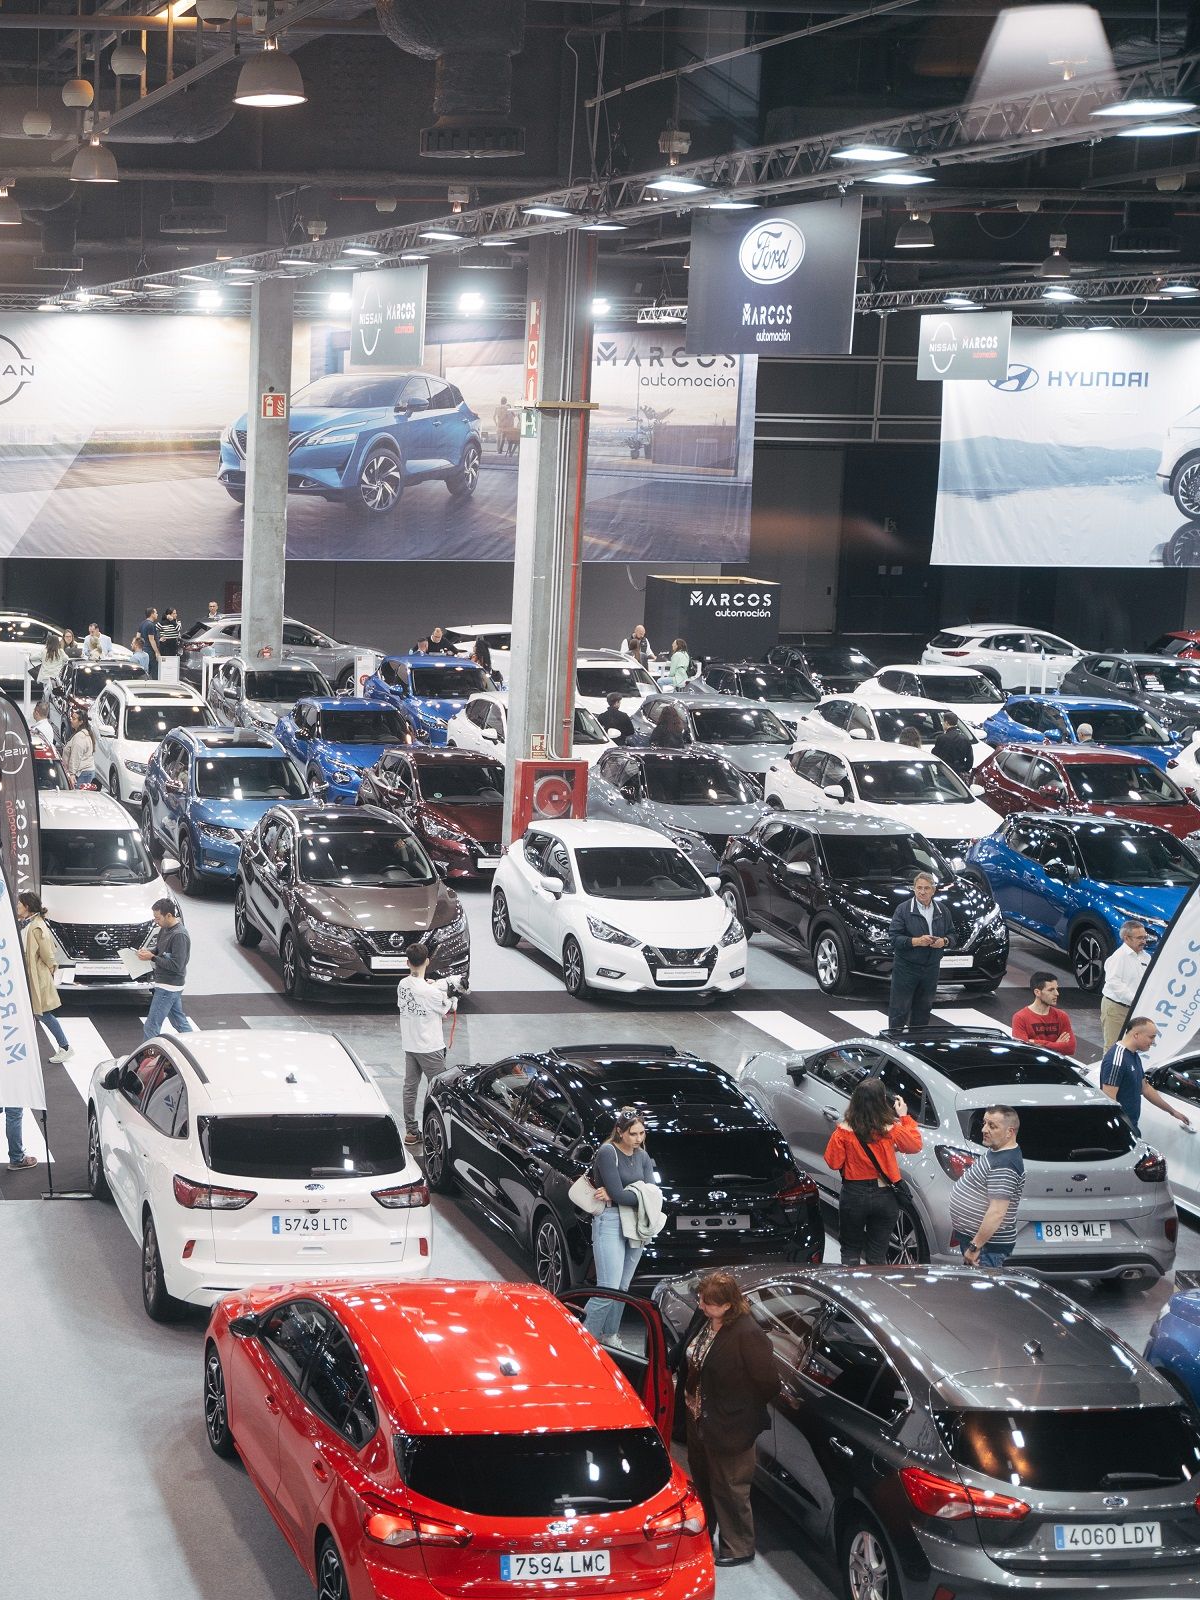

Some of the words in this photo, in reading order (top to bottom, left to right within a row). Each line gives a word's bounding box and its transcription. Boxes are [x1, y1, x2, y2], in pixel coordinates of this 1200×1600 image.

[751, 230, 792, 271] Ford
[359, 312, 383, 325] NISSAN
[742, 303, 793, 326] MARCOS
[756, 329, 791, 342] automoción
[962, 335, 999, 349] MARCOS
[928, 343, 958, 352] NISSAN
[640, 372, 736, 388] automoción
[1047, 370, 1149, 388] HYUNDAI
[689, 590, 772, 607] MARCOS
[714, 608, 771, 618] automoción
[284, 1218, 319, 1231] 5749
[323, 1218, 348, 1231] LTC
[1045, 1224, 1079, 1237] 8819
[1083, 1223, 1106, 1237] MLF
[1069, 1527, 1116, 1546] 4060
[1122, 1525, 1155, 1544] LDY
[515, 1556, 564, 1576] 7594
[570, 1554, 606, 1573] LMC
